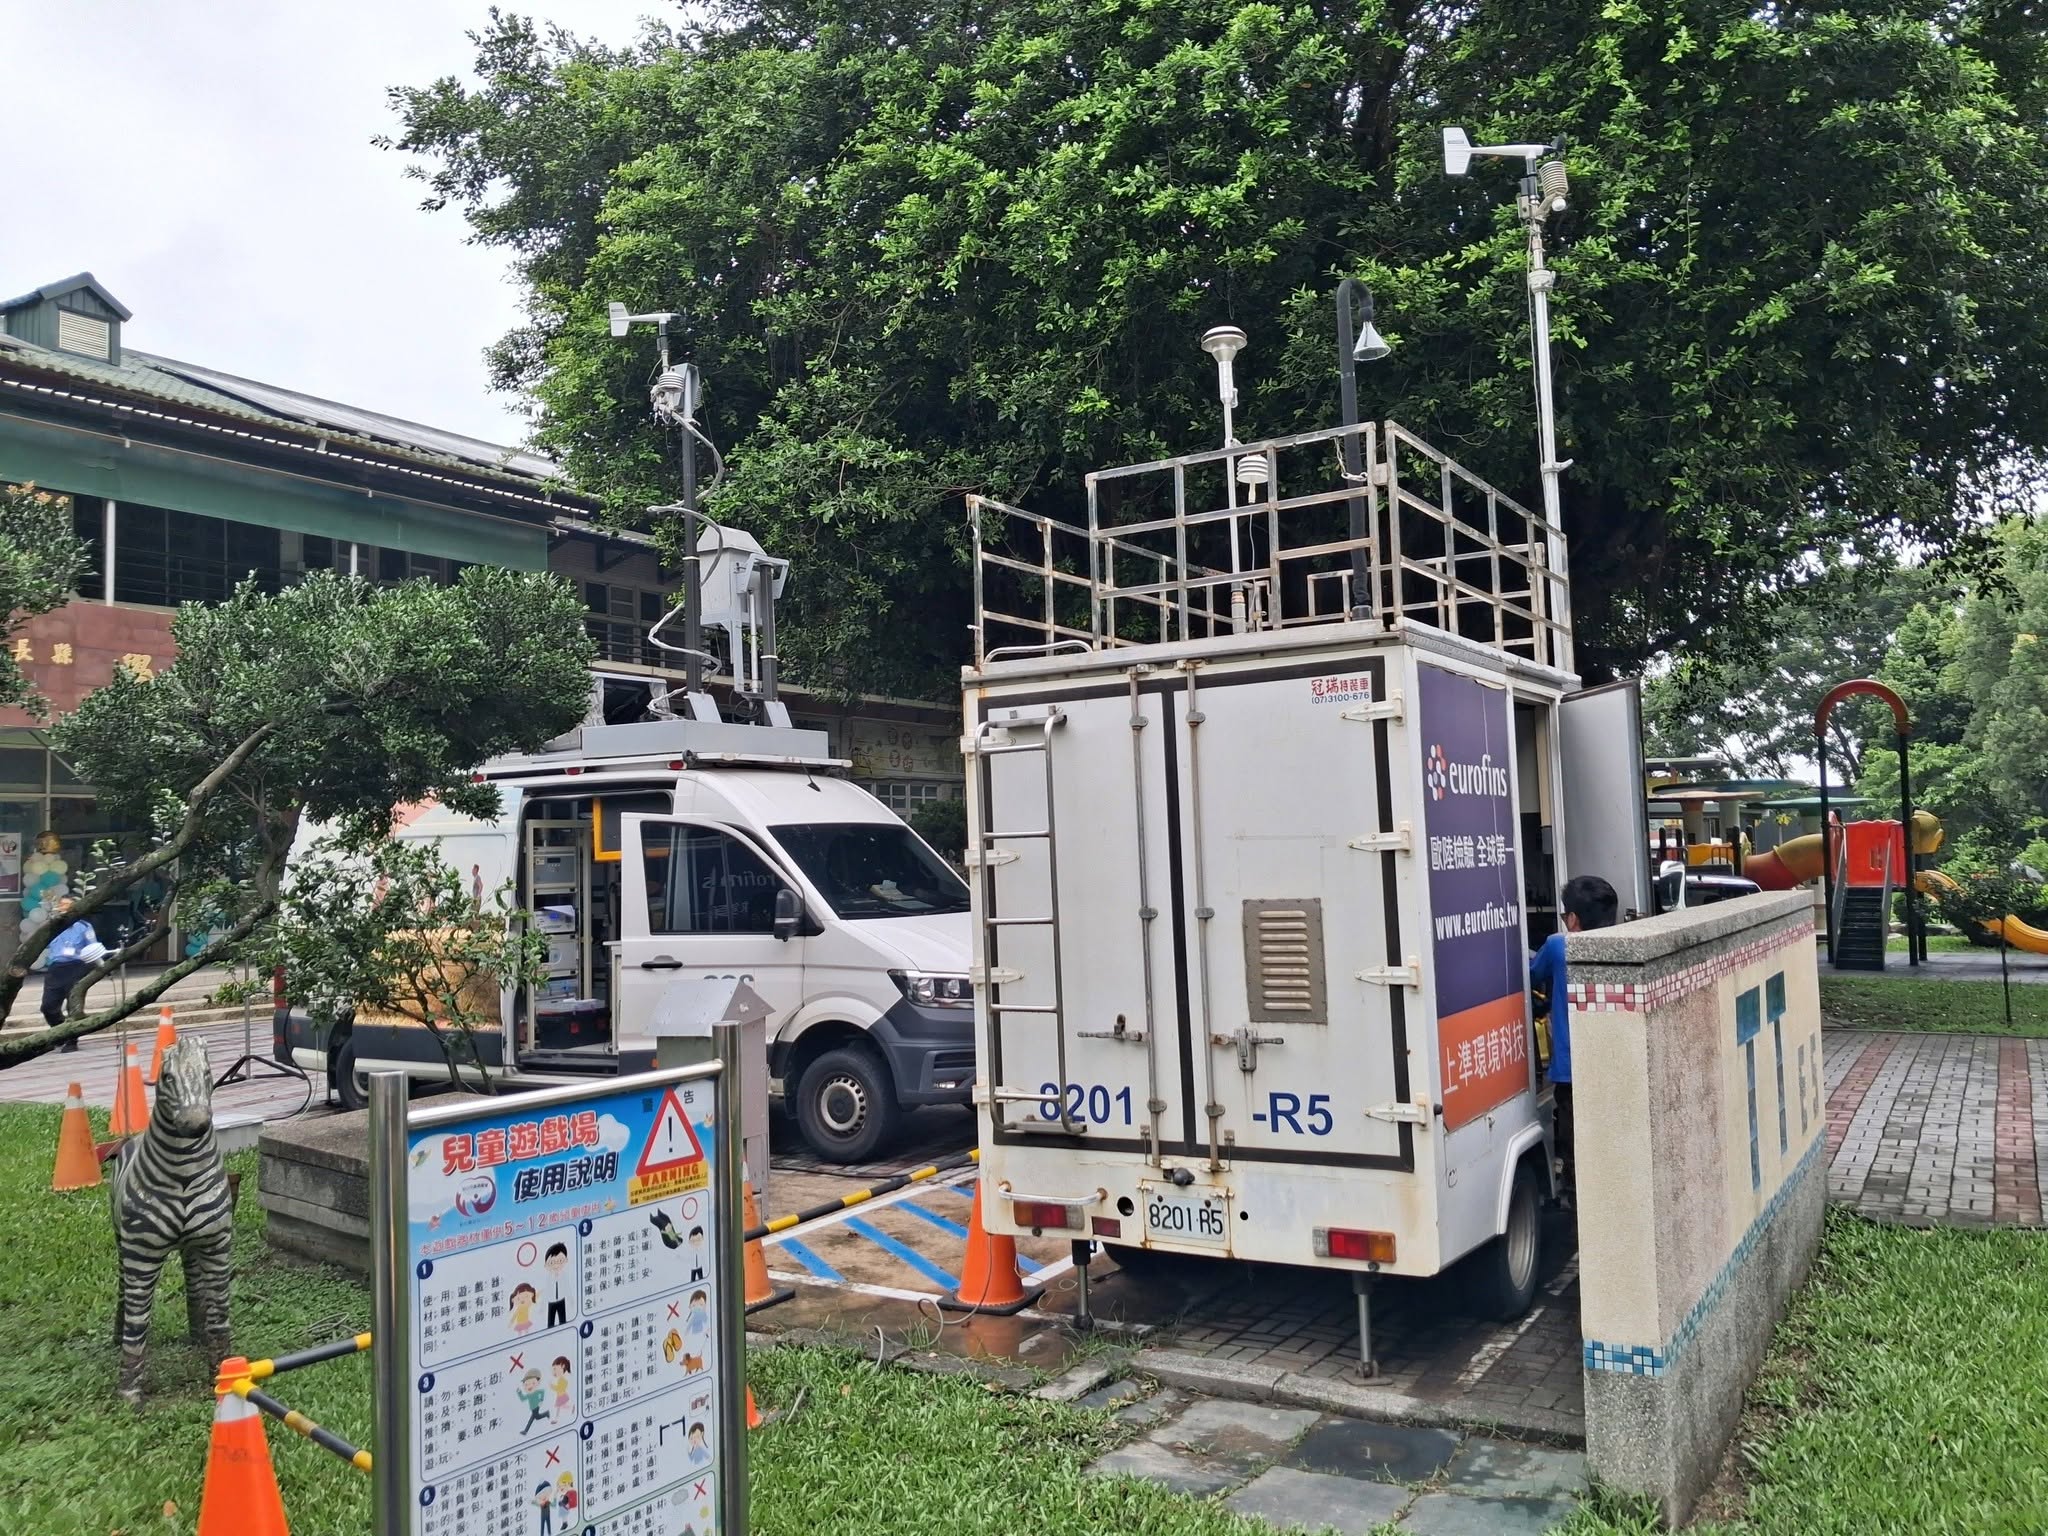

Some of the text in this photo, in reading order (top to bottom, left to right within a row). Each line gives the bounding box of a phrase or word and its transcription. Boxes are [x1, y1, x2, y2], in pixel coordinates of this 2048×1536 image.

[1449, 753, 1508, 797] eurofins
[1430, 834, 1515, 871] 歐陸檢驗 全球第一
[1435, 901, 1518, 940] www.eurofins.tw
[1444, 1018, 1525, 1095] 上準環境科技
[683, 1090, 695, 1104] 告
[1039, 1082, 1132, 1125] 8201
[442, 1110, 599, 1177] 兒童遊戲場
[514, 1152, 619, 1203] 使用說明
[640, 1163, 699, 1187] WARNING
